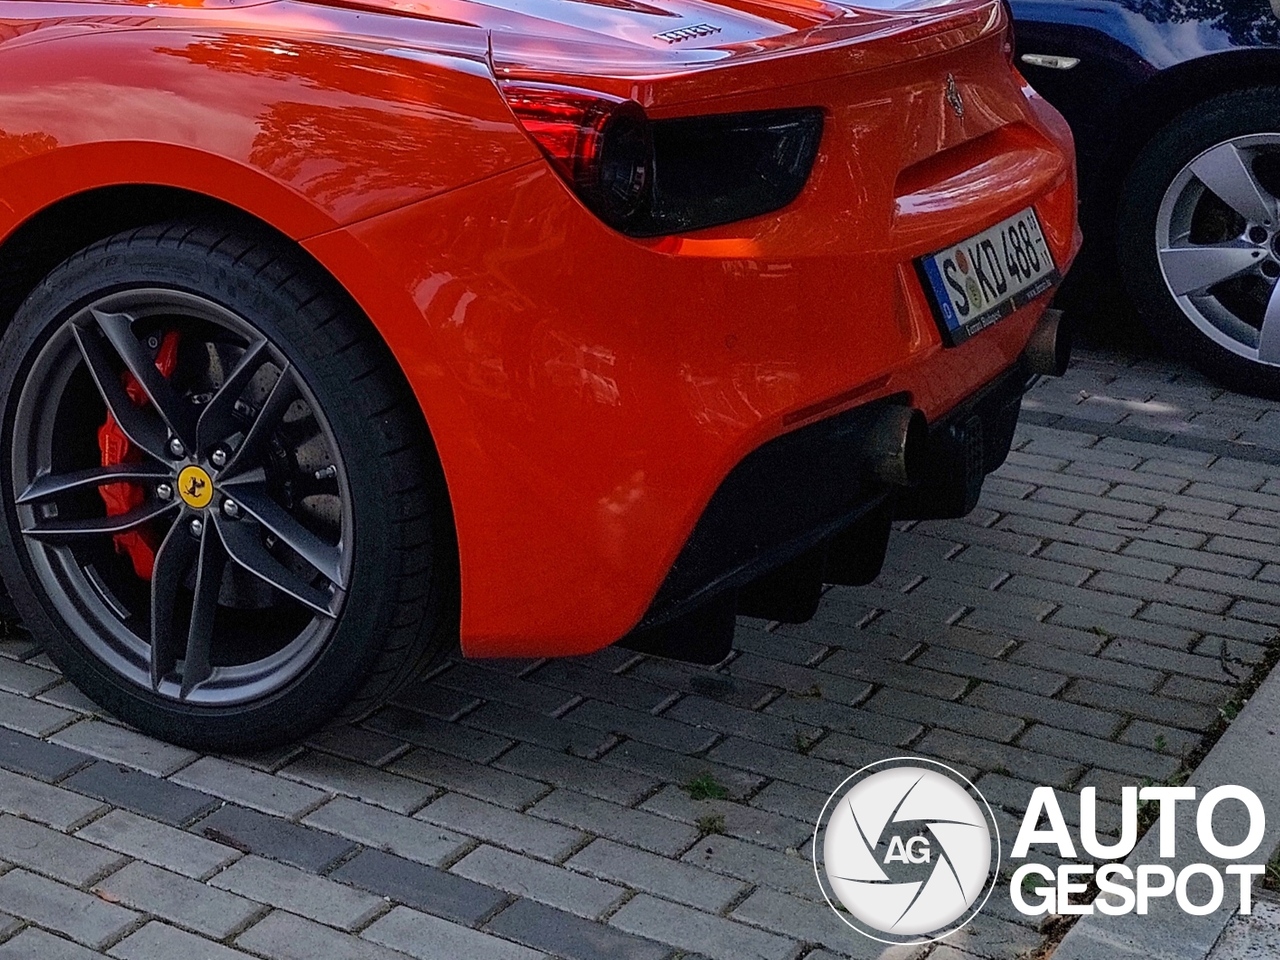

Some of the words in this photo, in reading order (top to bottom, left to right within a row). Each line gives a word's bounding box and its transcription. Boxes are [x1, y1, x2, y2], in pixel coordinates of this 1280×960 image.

[943, 258, 970, 316] S
[968, 238, 1007, 303] KD
[1001, 220, 1040, 284] 488
